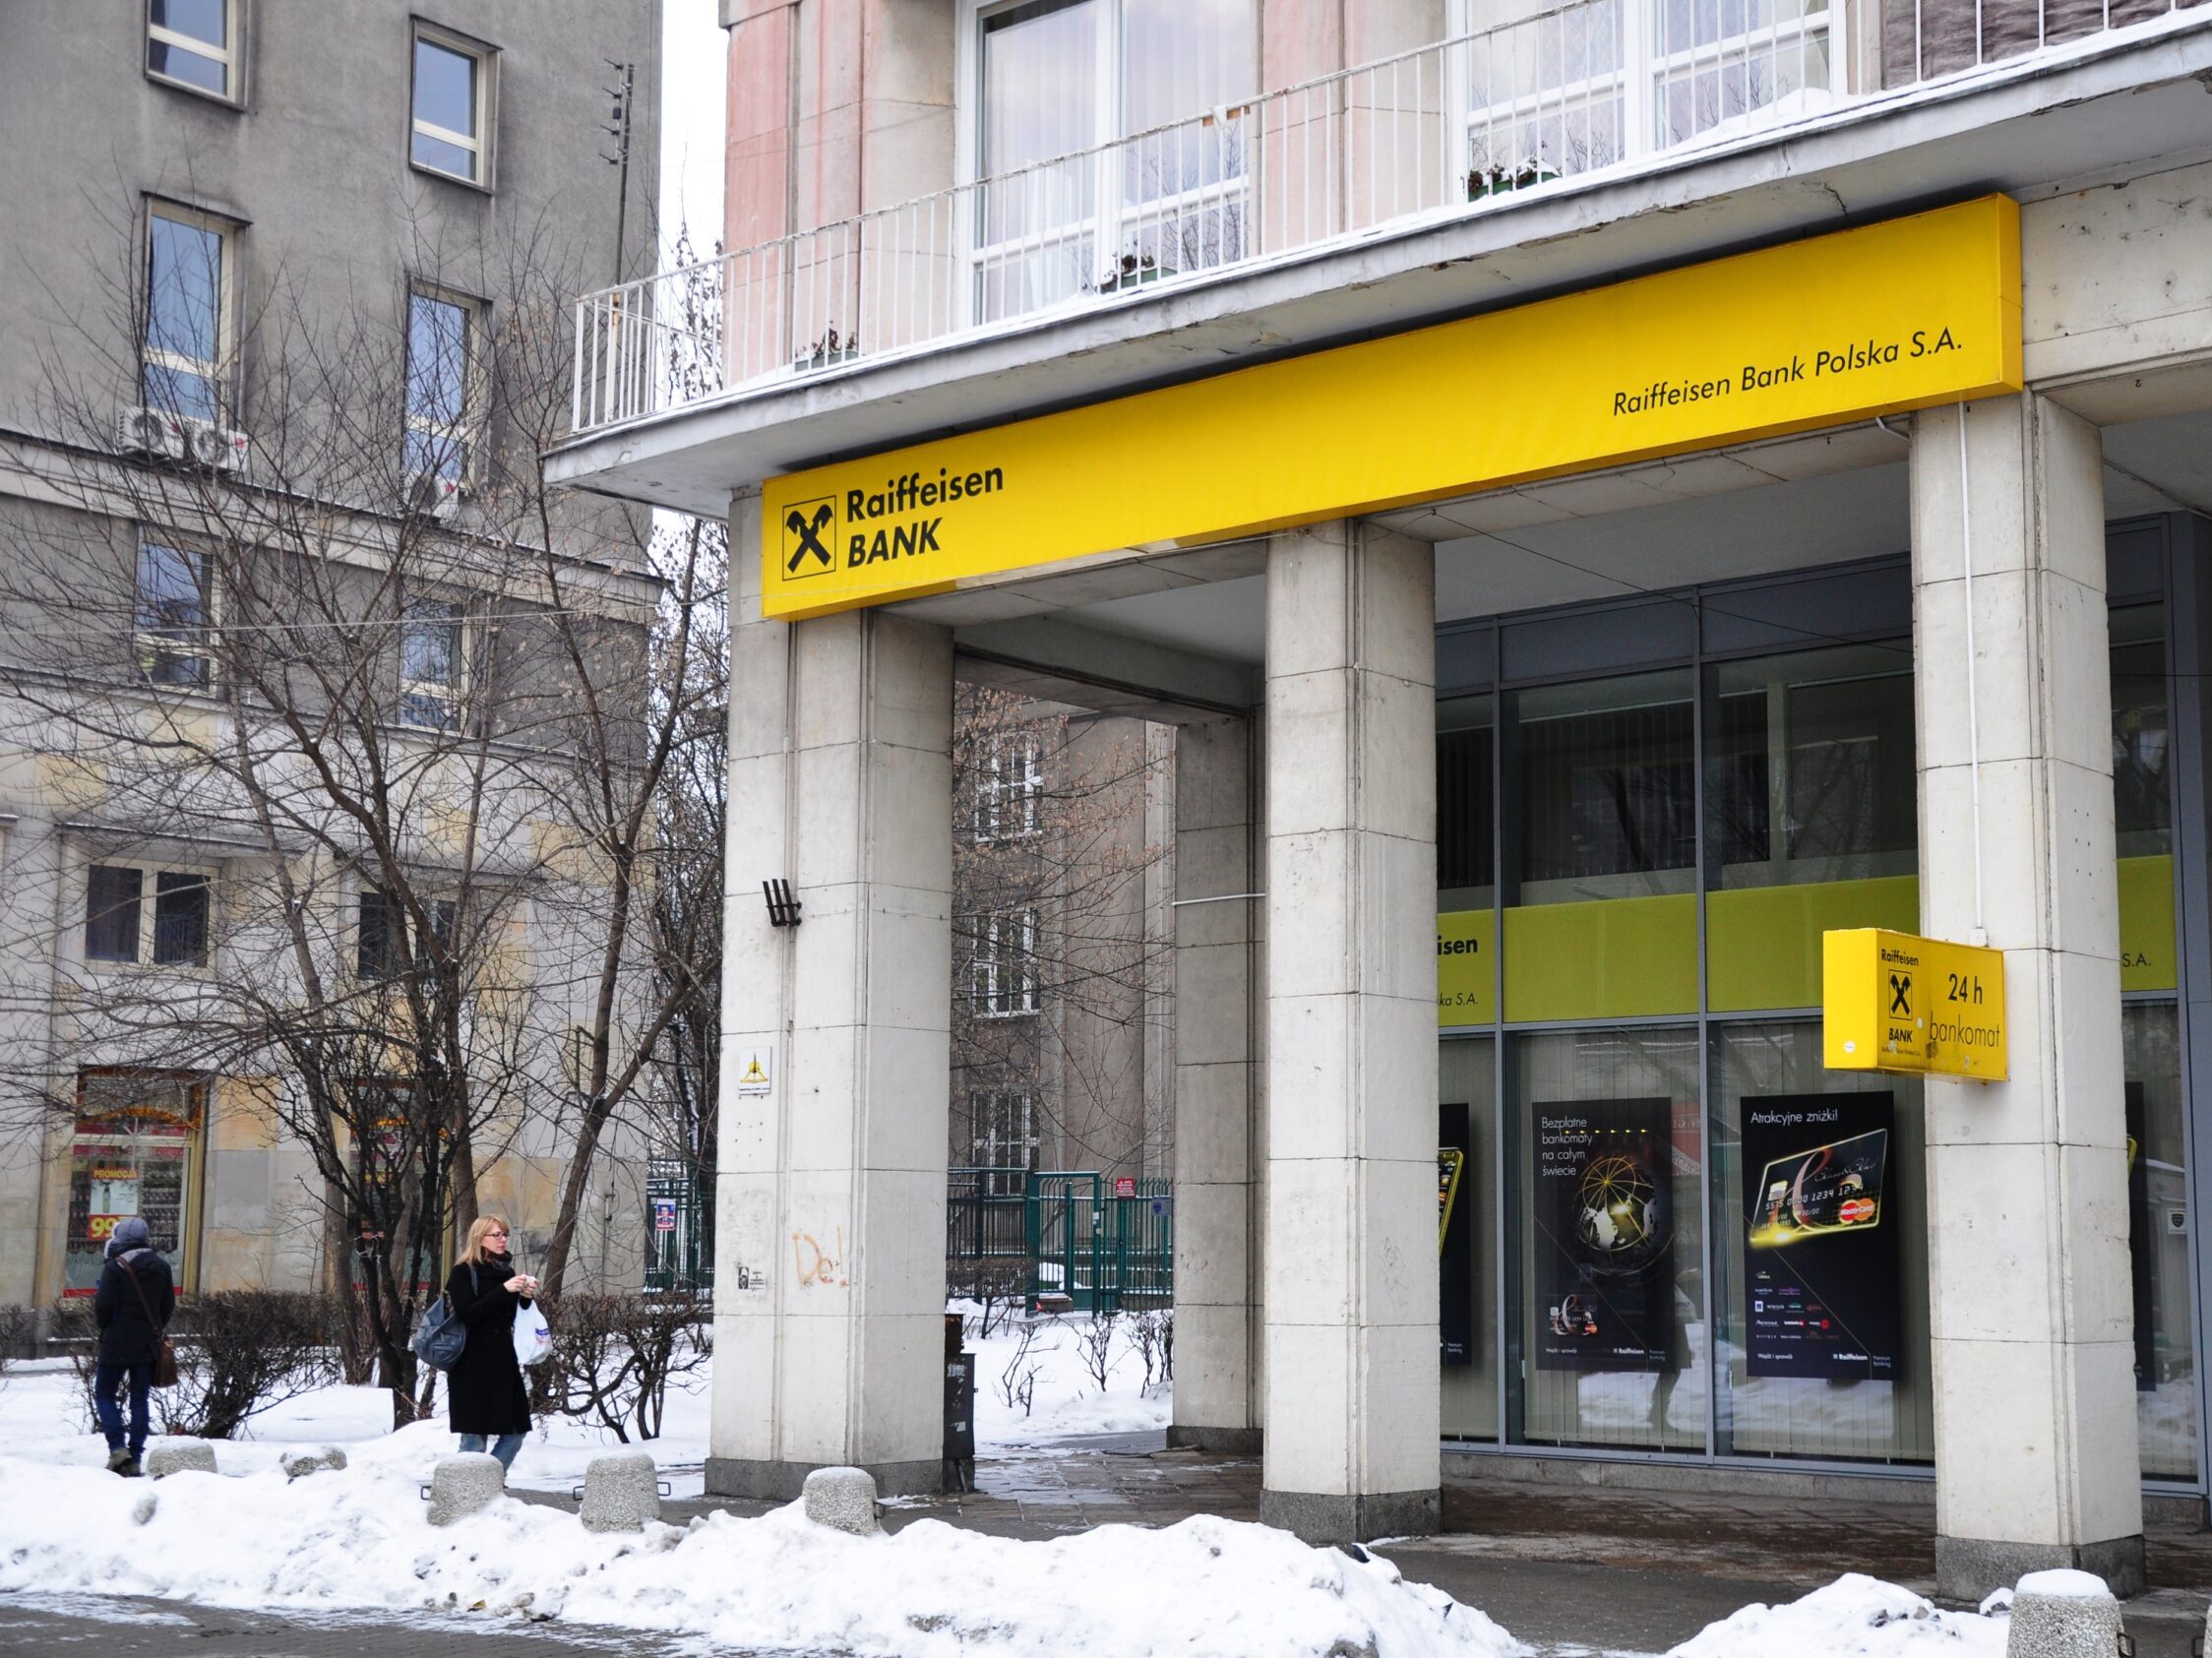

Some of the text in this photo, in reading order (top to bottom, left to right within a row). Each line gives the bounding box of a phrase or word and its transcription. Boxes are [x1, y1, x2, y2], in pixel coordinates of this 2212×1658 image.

[1613, 326, 1963, 417] Raiffeisen Bank Polska S.A.
[846, 466, 1004, 522] Raiffeisen
[847, 517, 944, 569] BANK
[1880, 948, 1919, 966] Raiffeisen
[2121, 952, 2152, 967] S.A.
[1947, 972, 1983, 1005] 24 h
[1455, 992, 1479, 1006] S.A.
[1888, 1027, 1913, 1043] BANK
[1930, 1010, 2000, 1048] bankomat
[1751, 1108, 1838, 1126] Atrakcyjne zniżki!
[1542, 1132, 1593, 1147] bankomaty
[1542, 1147, 1586, 1163] na całym
[93, 1169, 138, 1179] PROMOCJA
[1542, 1165, 1576, 1177] świecie
[1812, 1189, 1835, 1201] 1234
